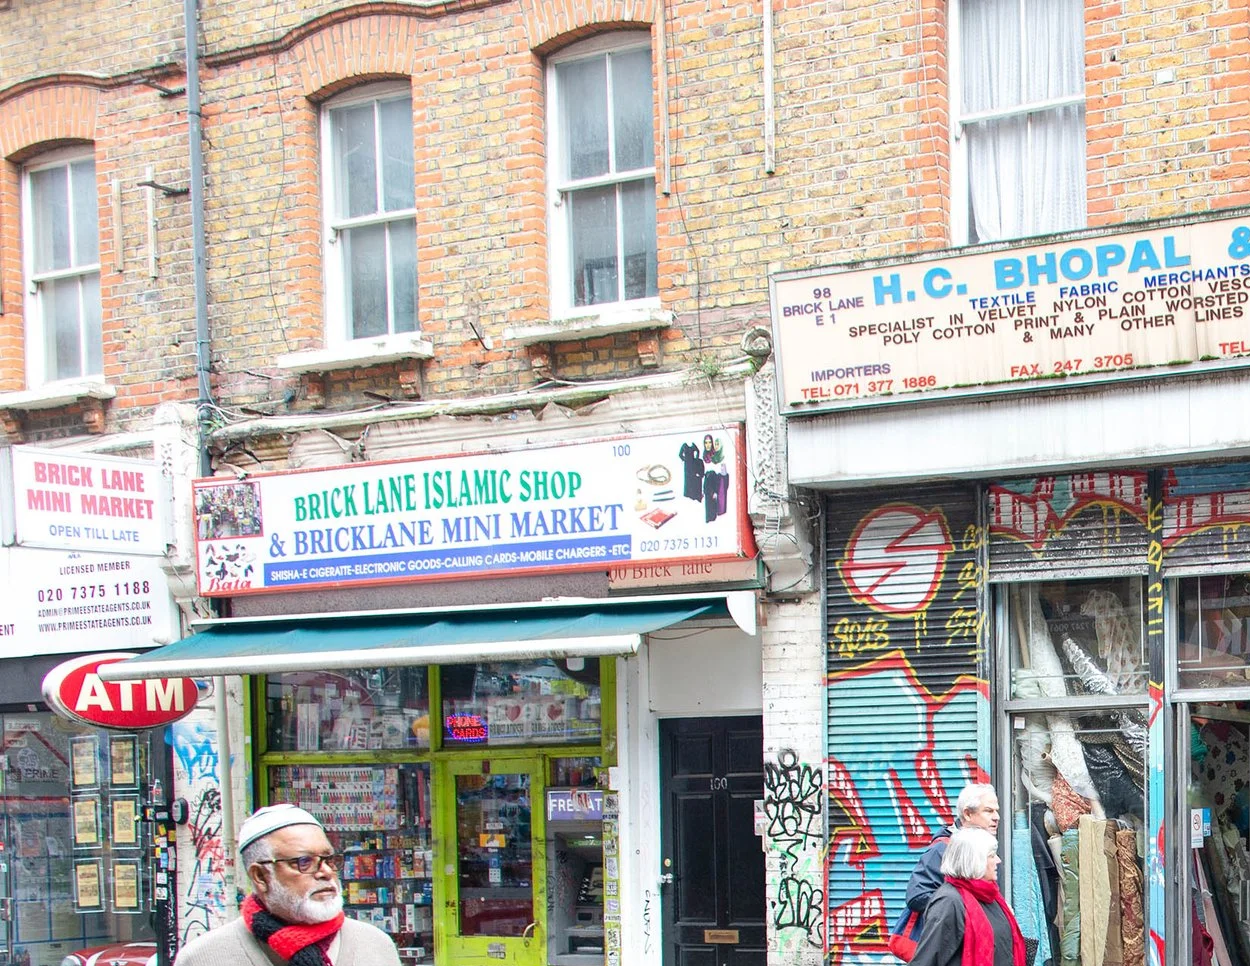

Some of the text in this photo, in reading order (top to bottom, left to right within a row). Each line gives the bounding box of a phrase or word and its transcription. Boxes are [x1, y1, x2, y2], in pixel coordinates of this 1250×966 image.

[993, 231, 1191, 290] BHOPAL
[813, 287, 832, 299] 98
[969, 263, 1250, 310] TEXTILE FABRIC MERCHANTS
[783, 296, 865, 317] BRICK LANE
[849, 316, 935, 338] SPECIALIST
[950, 313, 964, 326] IN
[977, 304, 1037, 322] VELVET
[1053, 295, 1107, 313] NYLON
[1121, 283, 1192, 303] COTTON
[816, 313, 837, 326] E 1
[883, 332, 920, 346] POLY
[932, 323, 996, 341] COTTON
[1014, 315, 1059, 331] PRINT
[1074, 311, 1085, 325] &
[1099, 304, 1146, 321] PLAIN
[1166, 290, 1249, 312] WORSTED
[1023, 306, 1244, 344] & MANY OTHER LINES
[811, 363, 891, 382] IMPORTERS
[1010, 354, 1134, 378] FAX. 247 3705
[868, 379, 894, 393] 377
[902, 375, 937, 389] 1886
[612, 444, 631, 457] 100
[34, 460, 145, 493] BRICK LANE
[27, 489, 154, 521] MINI MARKET
[295, 468, 583, 523] BRICK LANE ISLAMIC SHOP
[49, 524, 140, 543] OPEN TILL LATE
[269, 502, 624, 558] & BRICKLANE MINI MARKET
[640, 535, 720, 553] 020 7375 1131
[59, 560, 131, 576] LICENSED MEMBER
[271, 567, 309, 582] SHISHA-E
[309, 557, 405, 578] CIGERATTE-ELECTRONIC
[407, 550, 484, 572] GOODS-CALLING
[483, 548, 554, 566] CARDS-MOBILE
[557, 546, 606, 560] CHARGERS
[38, 580, 150, 603] 020 7375 1188
[206, 576, 251, 593] Bata
[38, 616, 152, 633] WWW.PRIMEESTATEAGENTS.CO.UK
[75, 671, 185, 713] ATM
[447, 717, 480, 727] PHONE
[453, 728, 486, 738] CARDS
